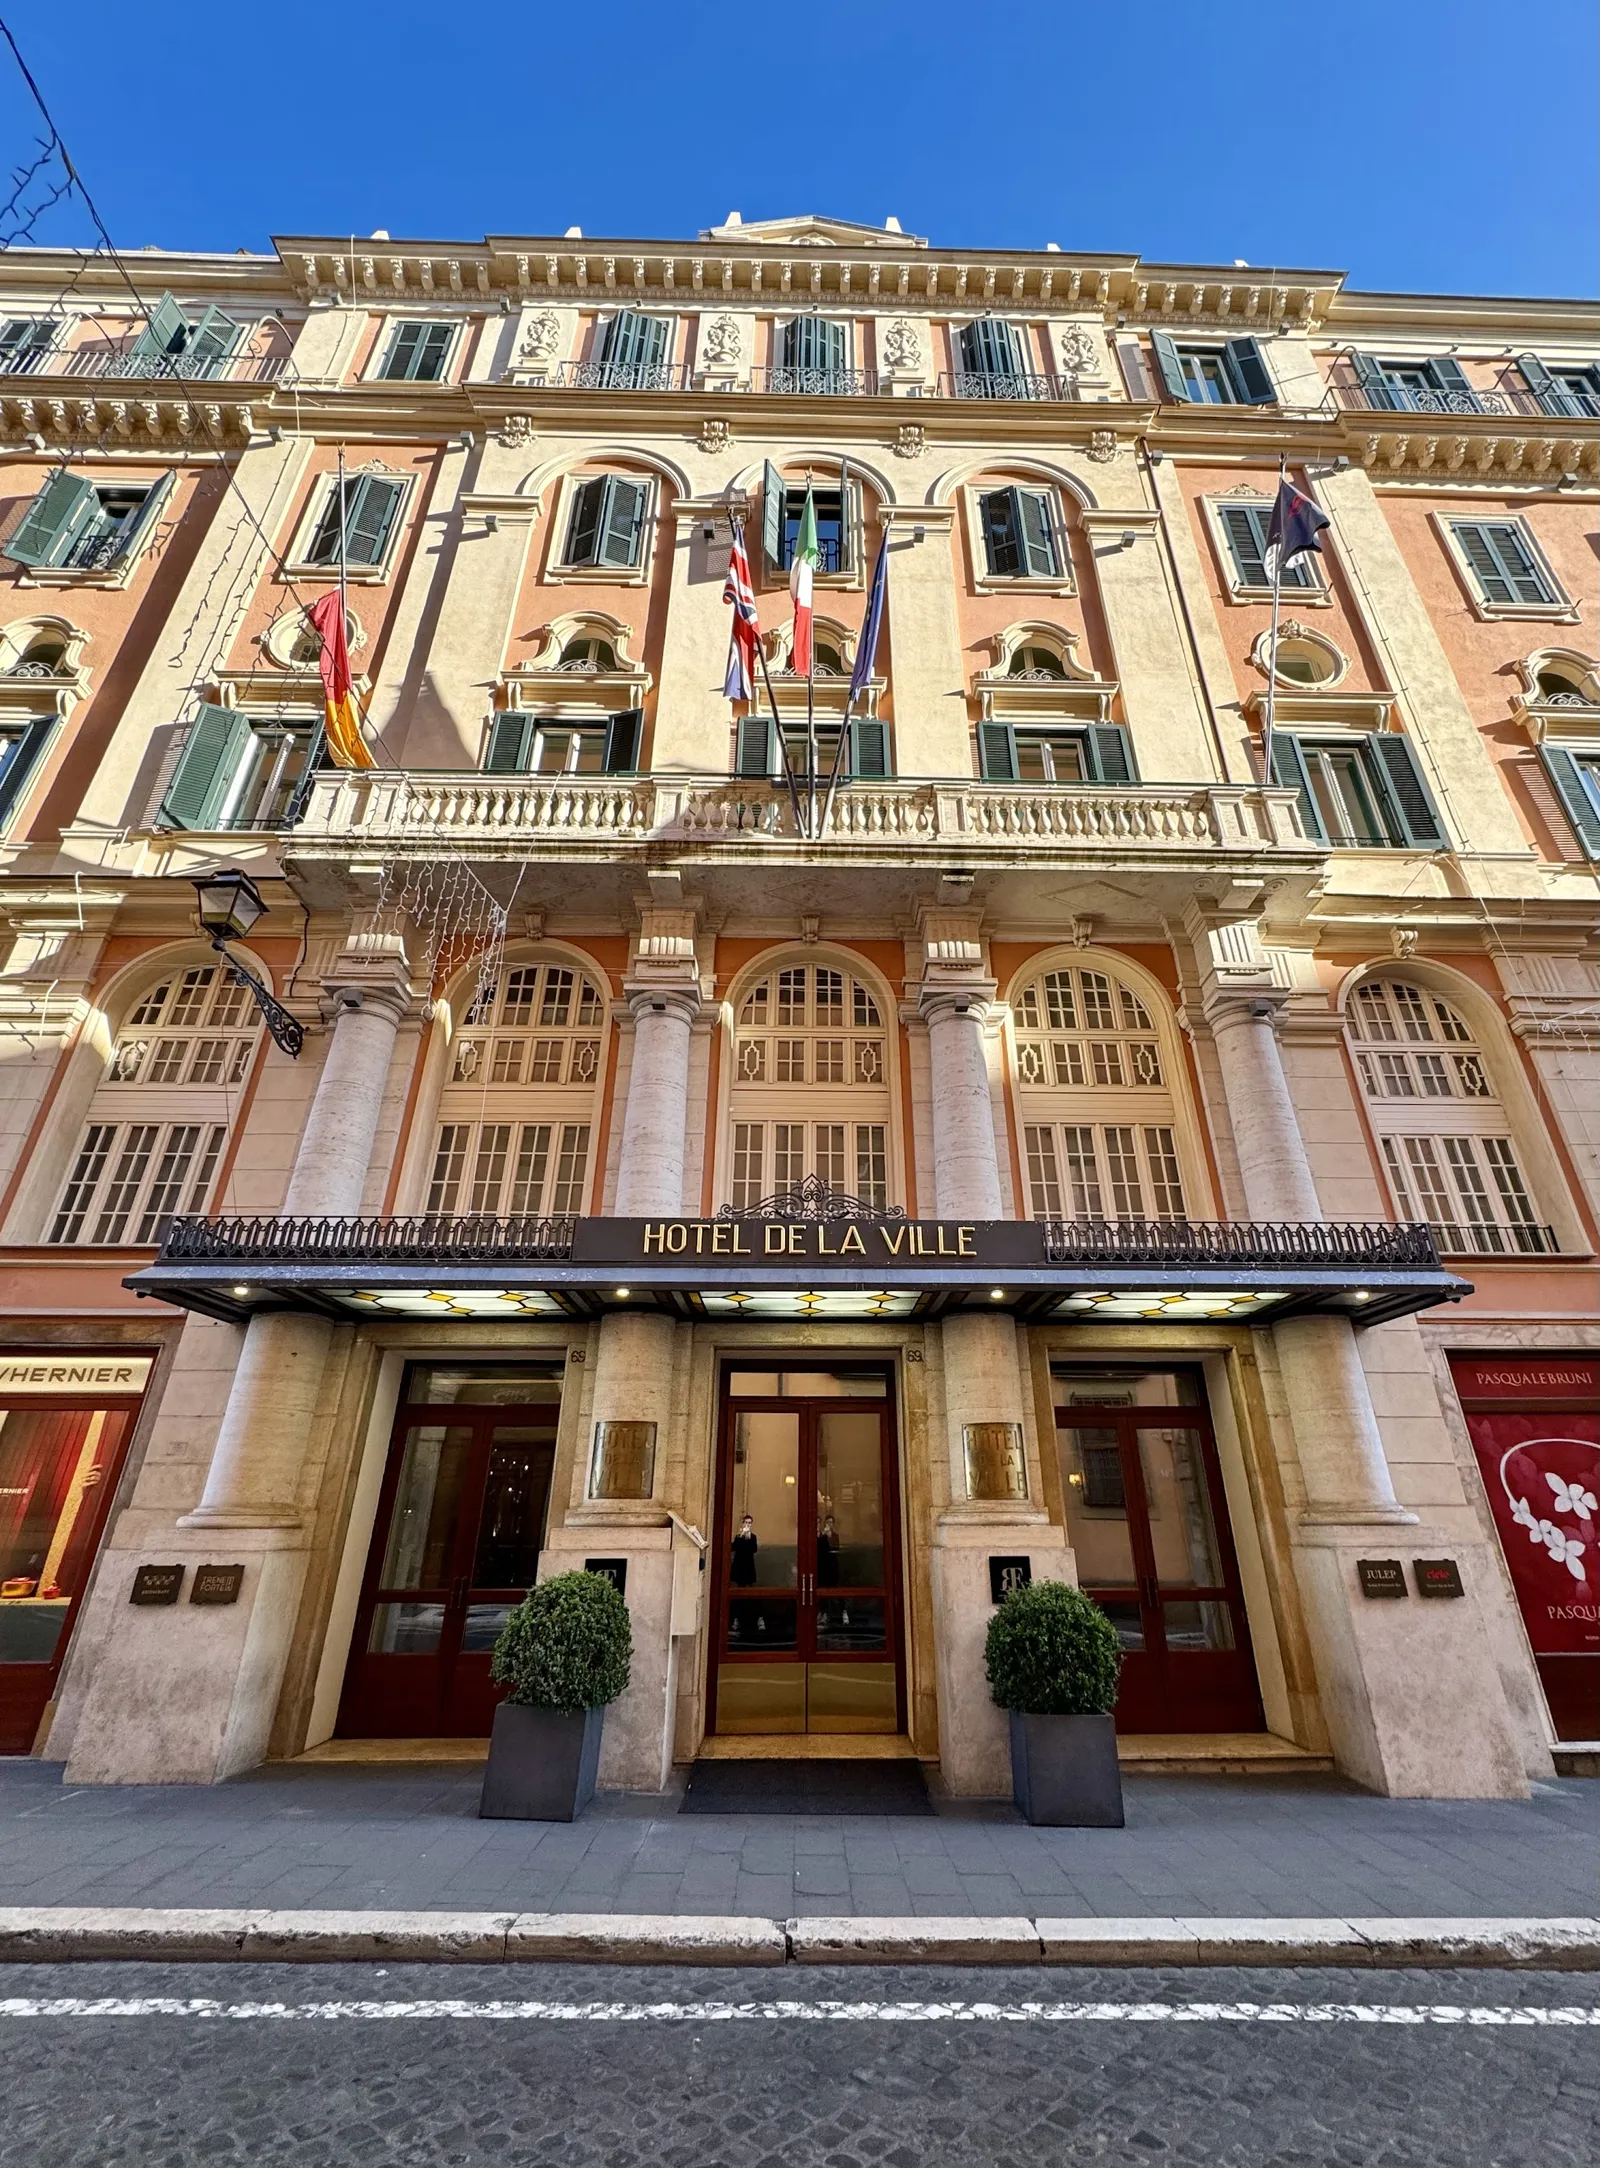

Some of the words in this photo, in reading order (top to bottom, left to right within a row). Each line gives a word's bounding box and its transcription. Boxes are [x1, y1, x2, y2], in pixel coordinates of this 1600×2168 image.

[643, 1223, 751, 1255] HOTEL
[764, 1224, 807, 1255] DE
[818, 1225, 866, 1256] LA
[879, 1226, 978, 1256] VILLE
[1000, 1454, 1015, 1466] LA
[1366, 1569, 1397, 1580] JULEP
[1547, 1605, 1600, 1622] PASQU
